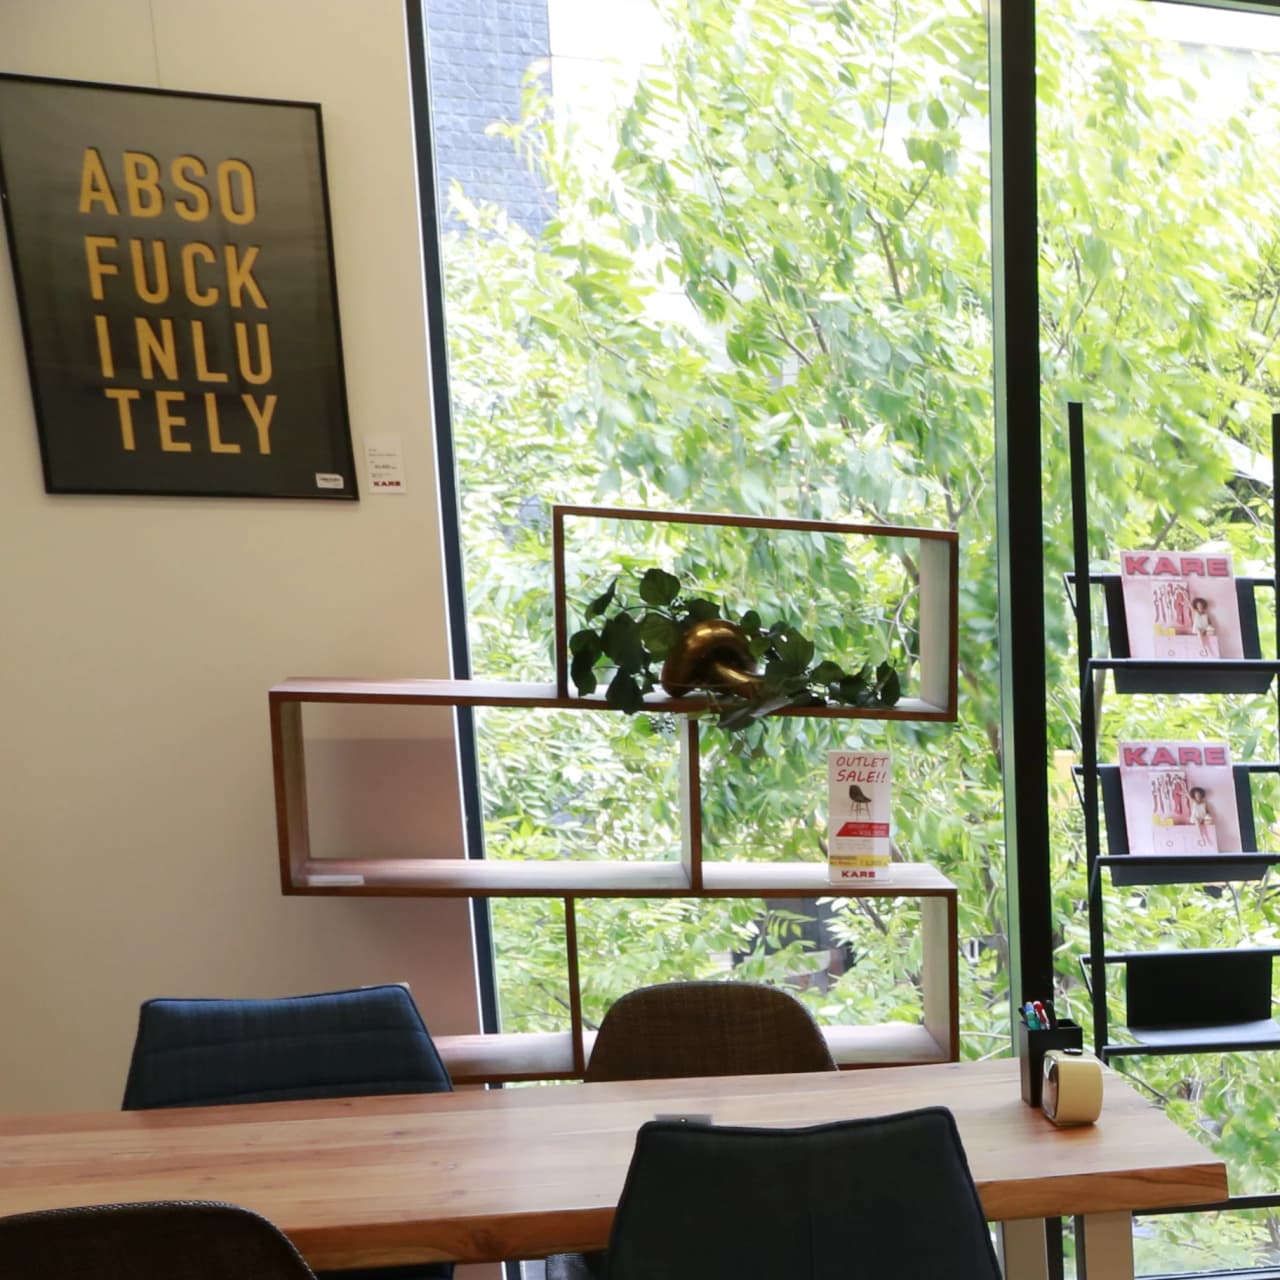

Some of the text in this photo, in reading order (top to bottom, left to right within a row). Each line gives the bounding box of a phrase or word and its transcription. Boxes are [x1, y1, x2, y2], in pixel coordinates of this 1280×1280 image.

[79, 148, 257, 226] ABSO
[84, 235, 268, 309] FUCK
[95, 315, 273, 385] INLU
[105, 388, 278, 455] TELY
[1124, 556, 1230, 577] KARE
[836, 755, 888, 768] OUTLET
[1122, 745, 1227, 767] KARE
[836, 768, 887, 784] SALE!!
[841, 870, 876, 878] KARE
